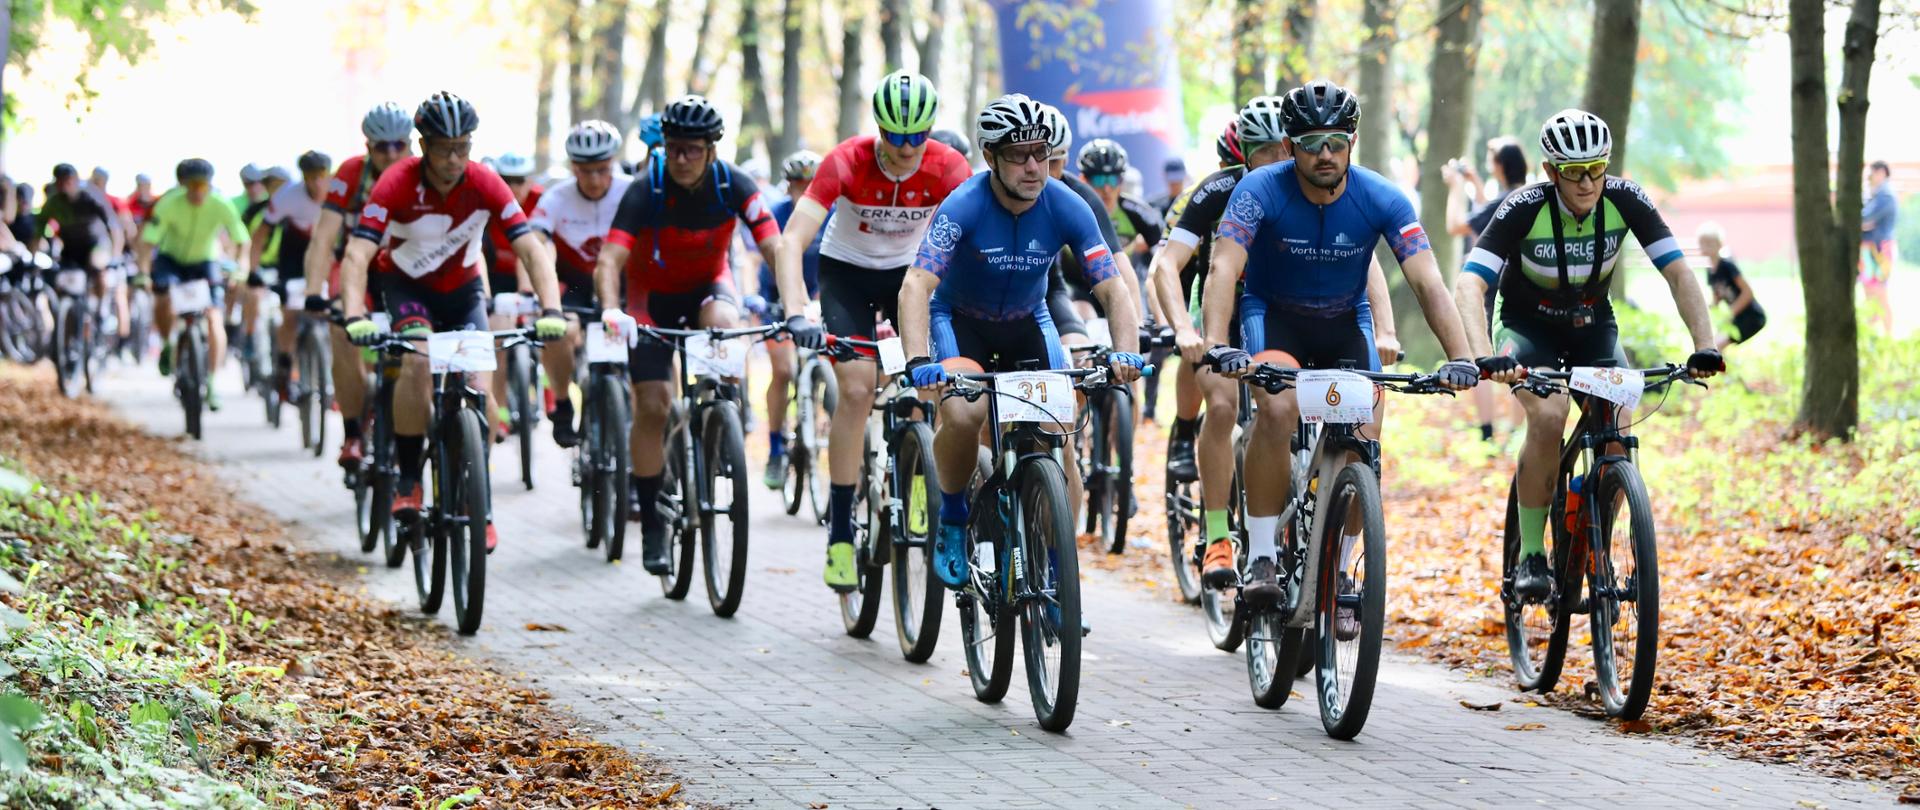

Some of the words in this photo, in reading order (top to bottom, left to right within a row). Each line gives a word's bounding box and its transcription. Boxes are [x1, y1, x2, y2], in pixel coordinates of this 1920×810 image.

[1010, 129, 1046, 142] CLIMB
[1204, 175, 1236, 193] PELETON
[1605, 180, 1622, 190] GKK
[1496, 203, 1512, 220] GKK
[1511, 187, 1544, 208] PELETON
[1334, 246, 1365, 258] Equity
[1564, 236, 1618, 258] PELEON
[987, 255, 1025, 264] Vortune
[1018, 381, 1047, 403] 31
[1325, 382, 1341, 406] 6
